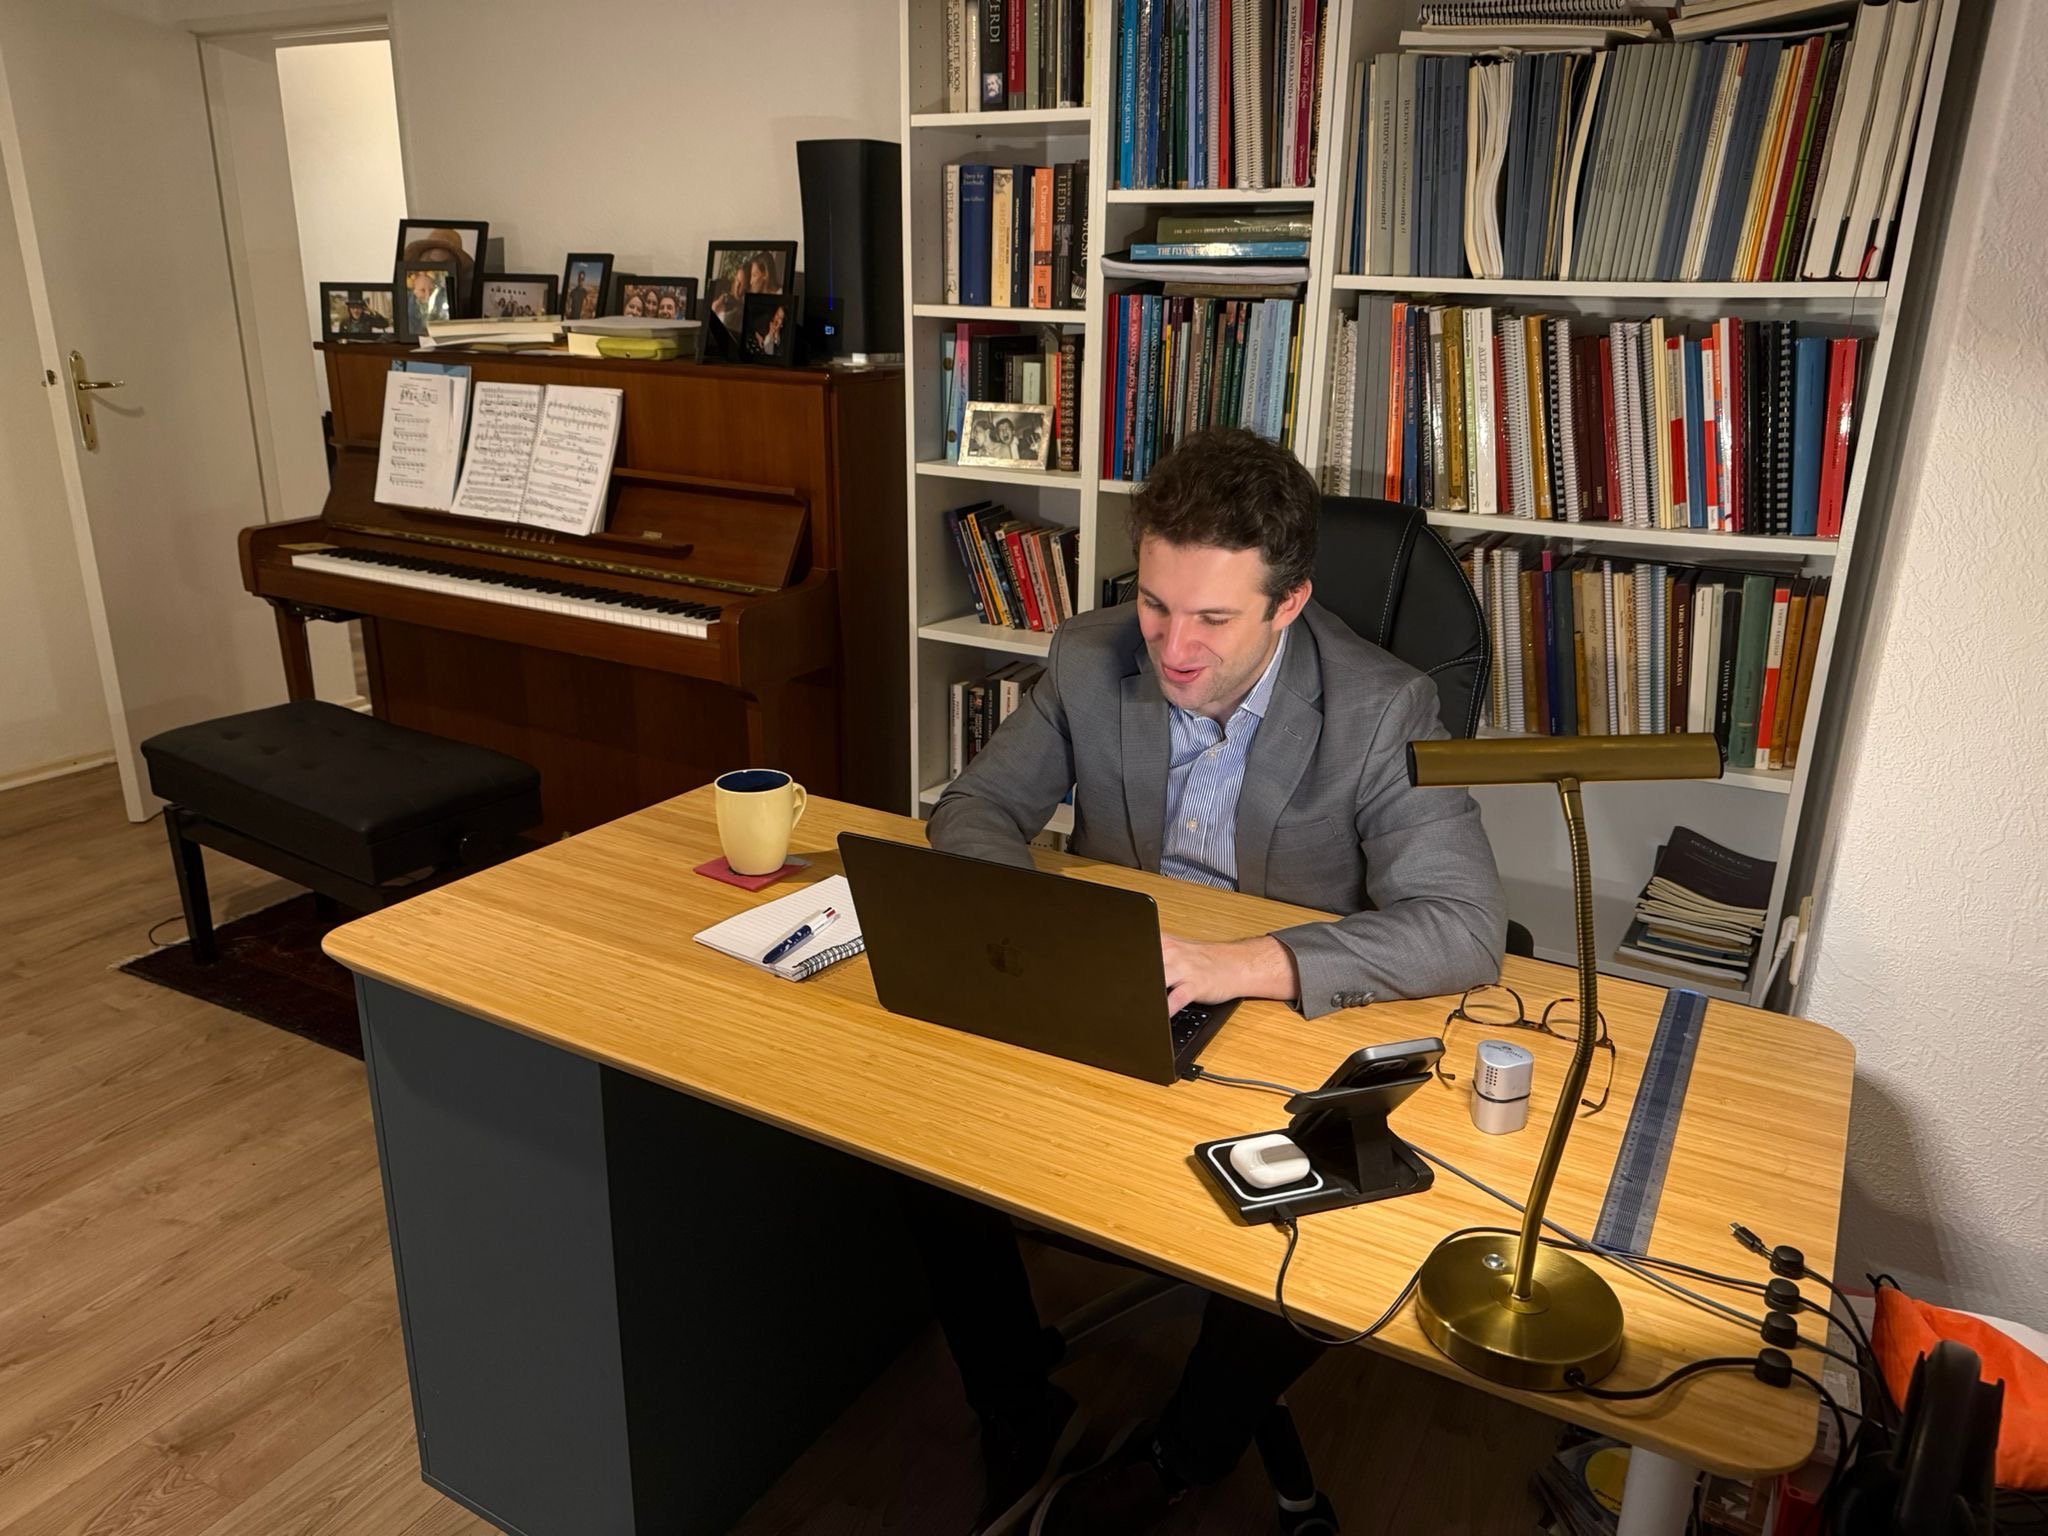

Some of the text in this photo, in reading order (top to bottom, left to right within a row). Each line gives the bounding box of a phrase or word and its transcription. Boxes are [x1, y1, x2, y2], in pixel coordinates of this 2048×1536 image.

[952, 12, 960, 93] COMPLETE BOOK
[1139, 54, 1147, 80] PIANO
[1138, 82, 1146, 128] CONCERTOS
[1382, 99, 1391, 155] BEETHOVEN
[1402, 99, 1411, 154] BEETHOVEN
[1040, 185, 1049, 224] Classical
[1056, 175, 1068, 223] LIEDER
[1380, 159, 1389, 224] Klaviersonaten
[998, 201, 1006, 288] SHOSTAKOVICH
[1157, 246, 1172, 257] THE
[1172, 246, 1195, 257] FLYING
[1250, 339, 1260, 372] COMPLETE
[1264, 349, 1273, 394] SYMPHONIES
[1434, 342, 1442, 380] BENJAMIN
[1250, 372, 1258, 394] PIANO
[1191, 387, 1200, 432] SYMPHONIES
[1422, 399, 1430, 424] OWEN
[1012, 545, 1026, 579] Bad Science
[1676, 648, 1684, 687] BOCCANEGRA
[1722, 692, 1728, 700] LA
